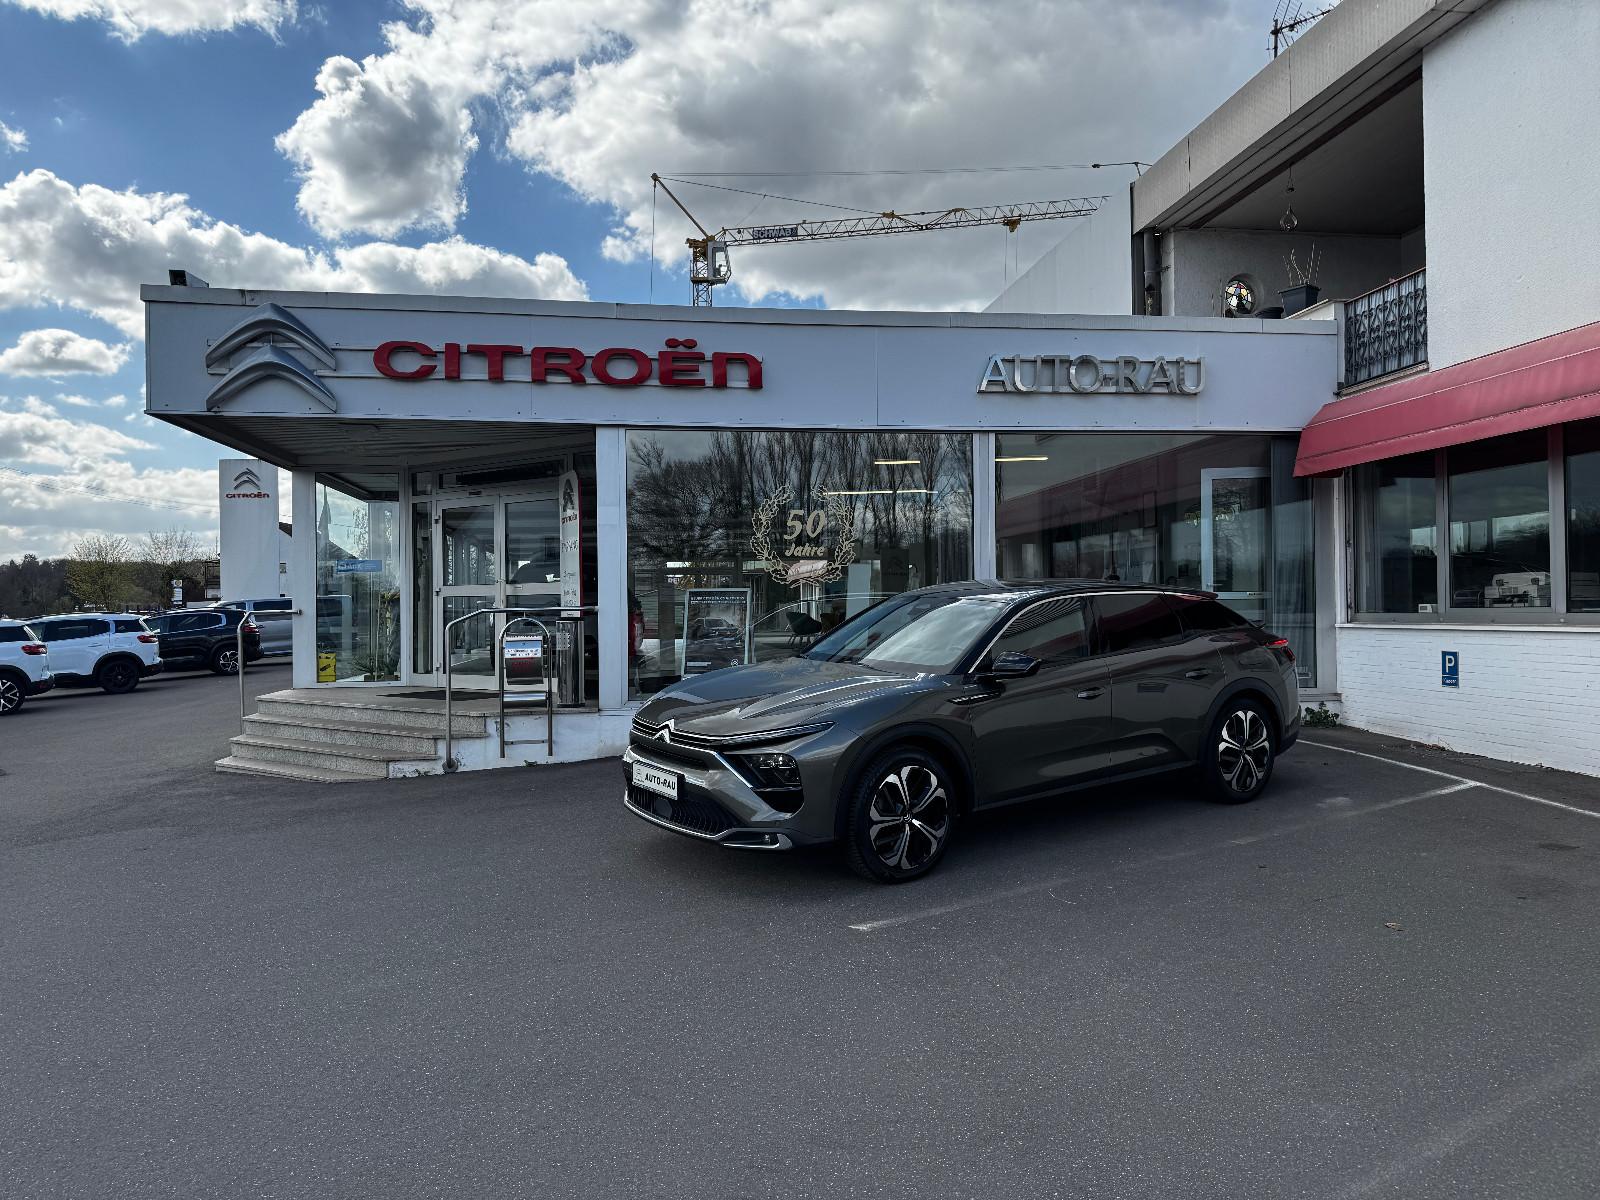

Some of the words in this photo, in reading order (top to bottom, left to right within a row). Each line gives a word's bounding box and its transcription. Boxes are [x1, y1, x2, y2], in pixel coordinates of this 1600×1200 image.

[753, 228, 791, 239] SCHWAB
[783, 509, 826, 540] 50
[784, 542, 826, 557] Jahre
[1445, 655, 1455, 673] P
[644, 772, 676, 791] AUTO-RAU
